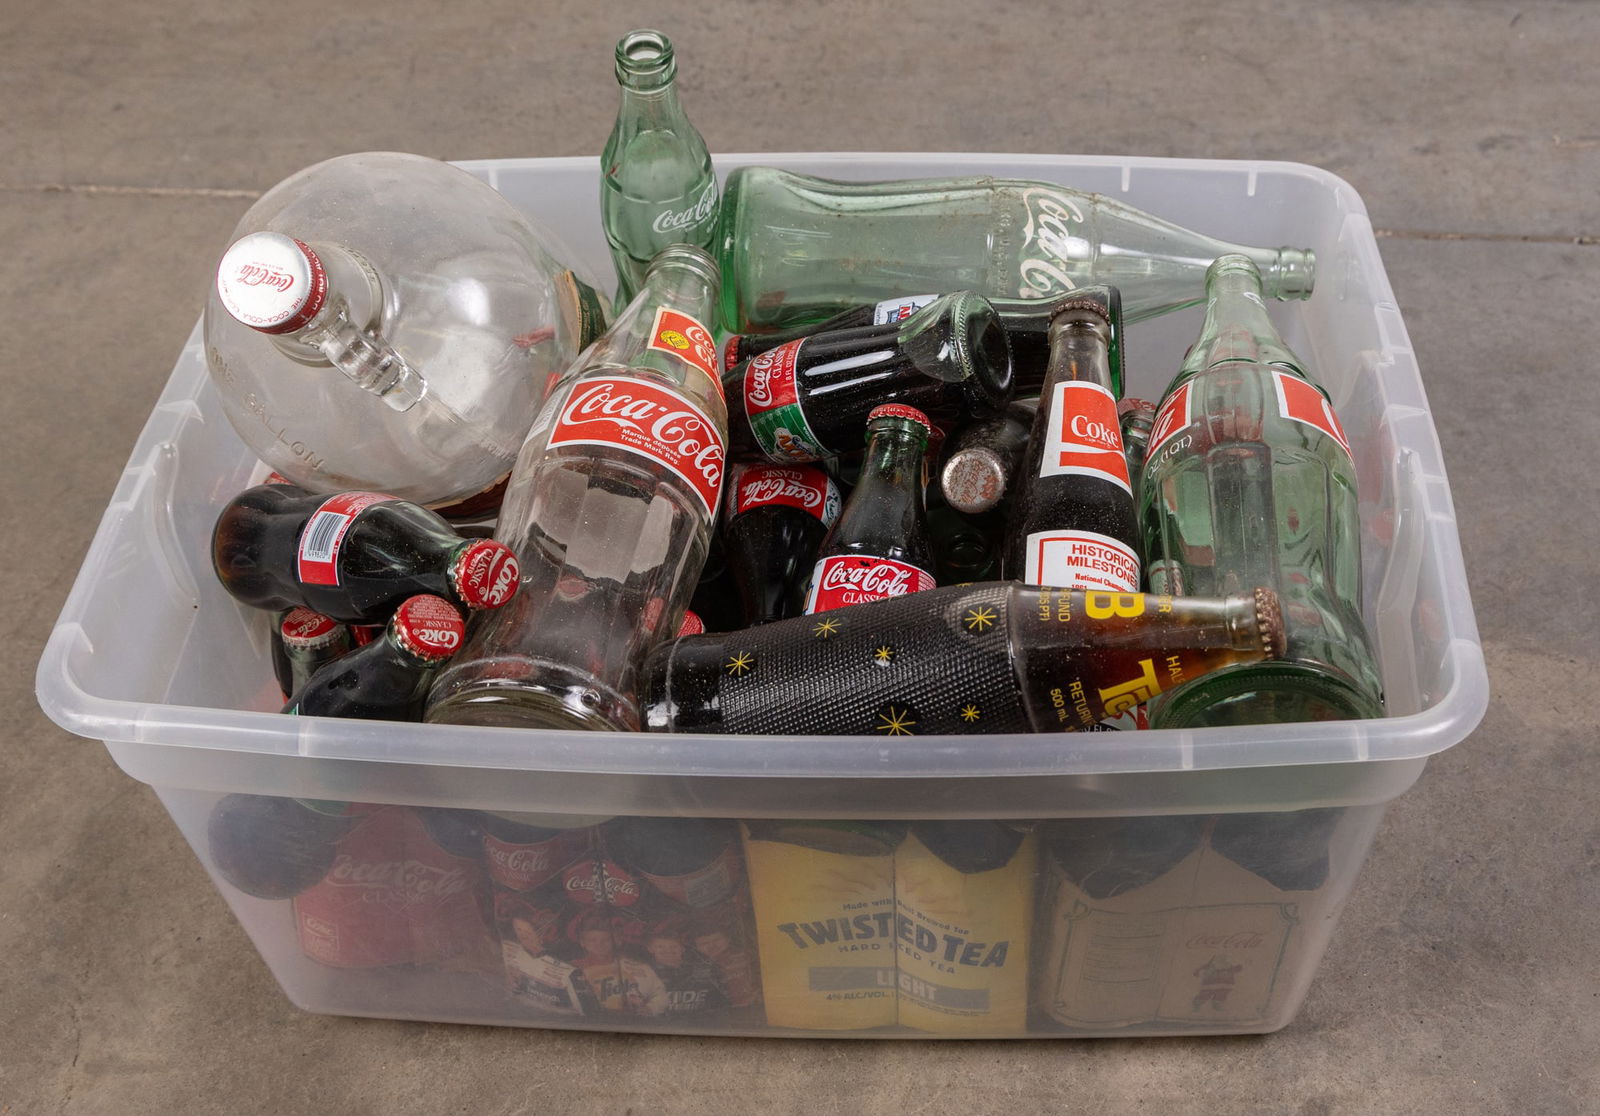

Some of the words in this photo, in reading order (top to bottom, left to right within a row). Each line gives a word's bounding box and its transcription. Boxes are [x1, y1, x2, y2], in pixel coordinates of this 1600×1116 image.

[652, 173, 719, 233] Coca-Col
[240, 262, 295, 293] Coca-Cola
[749, 347, 778, 407] Coca-Co
[561, 383, 724, 488] Coca-Cola
[620, 434, 643, 446] Trade
[643, 442, 664, 456] Mark
[621, 427, 651, 444] Marque
[1070, 415, 1119, 449] Coke
[762, 470, 803, 481] CLASSIC
[741, 478, 822, 508] Coca-Cola
[468, 549, 493, 588] CLASSIC
[1071, 543, 1140, 575] HISTORICAL
[488, 557, 520, 605] Coke
[823, 561, 912, 596] Coca-Cola
[1074, 572, 1103, 585] National
[418, 630, 459, 649] Coke
[1050, 688, 1064, 708] 500
[324, 854, 469, 896] Coca-Cola
[842, 899, 868, 911] Made
[777, 911, 938, 950] TWISTED
[943, 933, 1010, 968] TEA
[839, 943, 881, 952] HARD
[929, 959, 956, 974] TEA
[876, 971, 938, 1001] LIGHT
